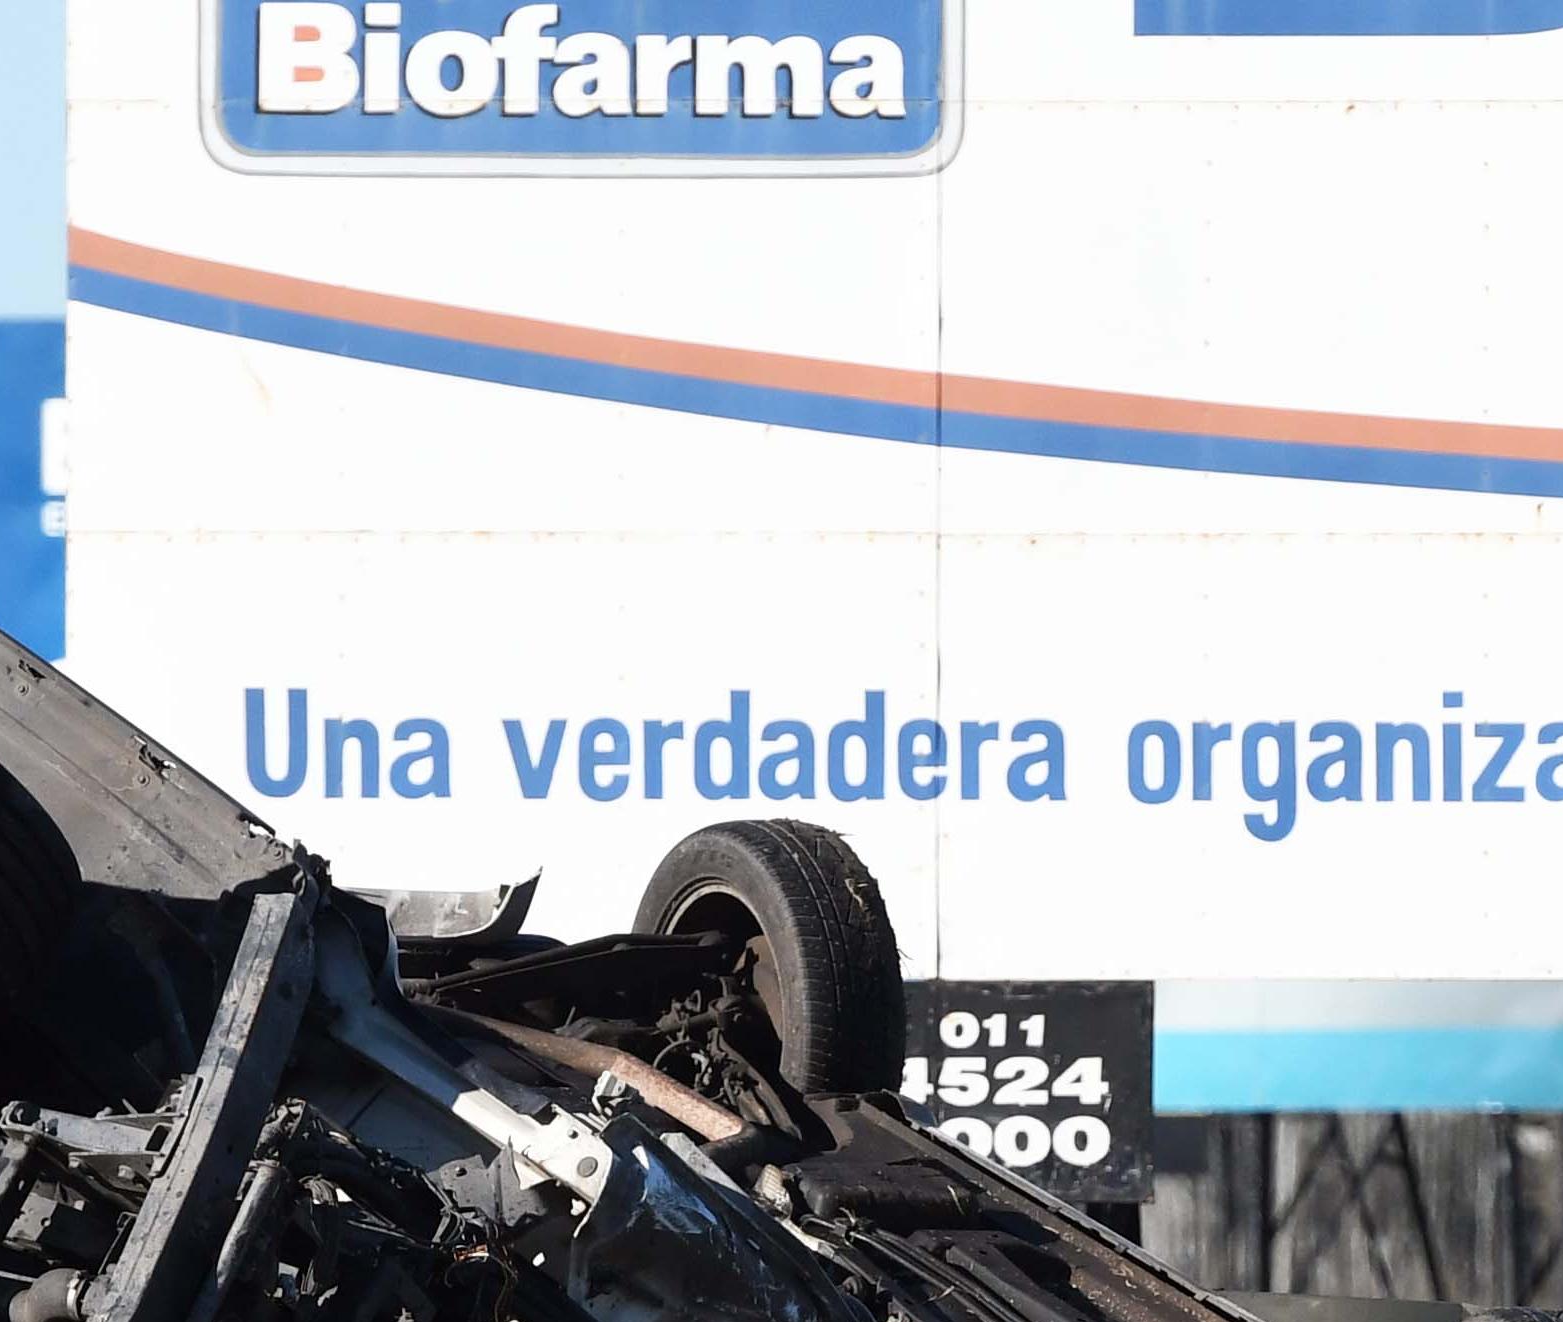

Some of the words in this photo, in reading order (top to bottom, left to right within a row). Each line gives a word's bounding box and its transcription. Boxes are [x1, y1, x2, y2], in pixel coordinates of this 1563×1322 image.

[257, 1, 908, 117] Biofarma
[246, 687, 451, 799] Una
[505, 690, 1065, 802] verdadera
[939, 1011, 1046, 1049] 011
